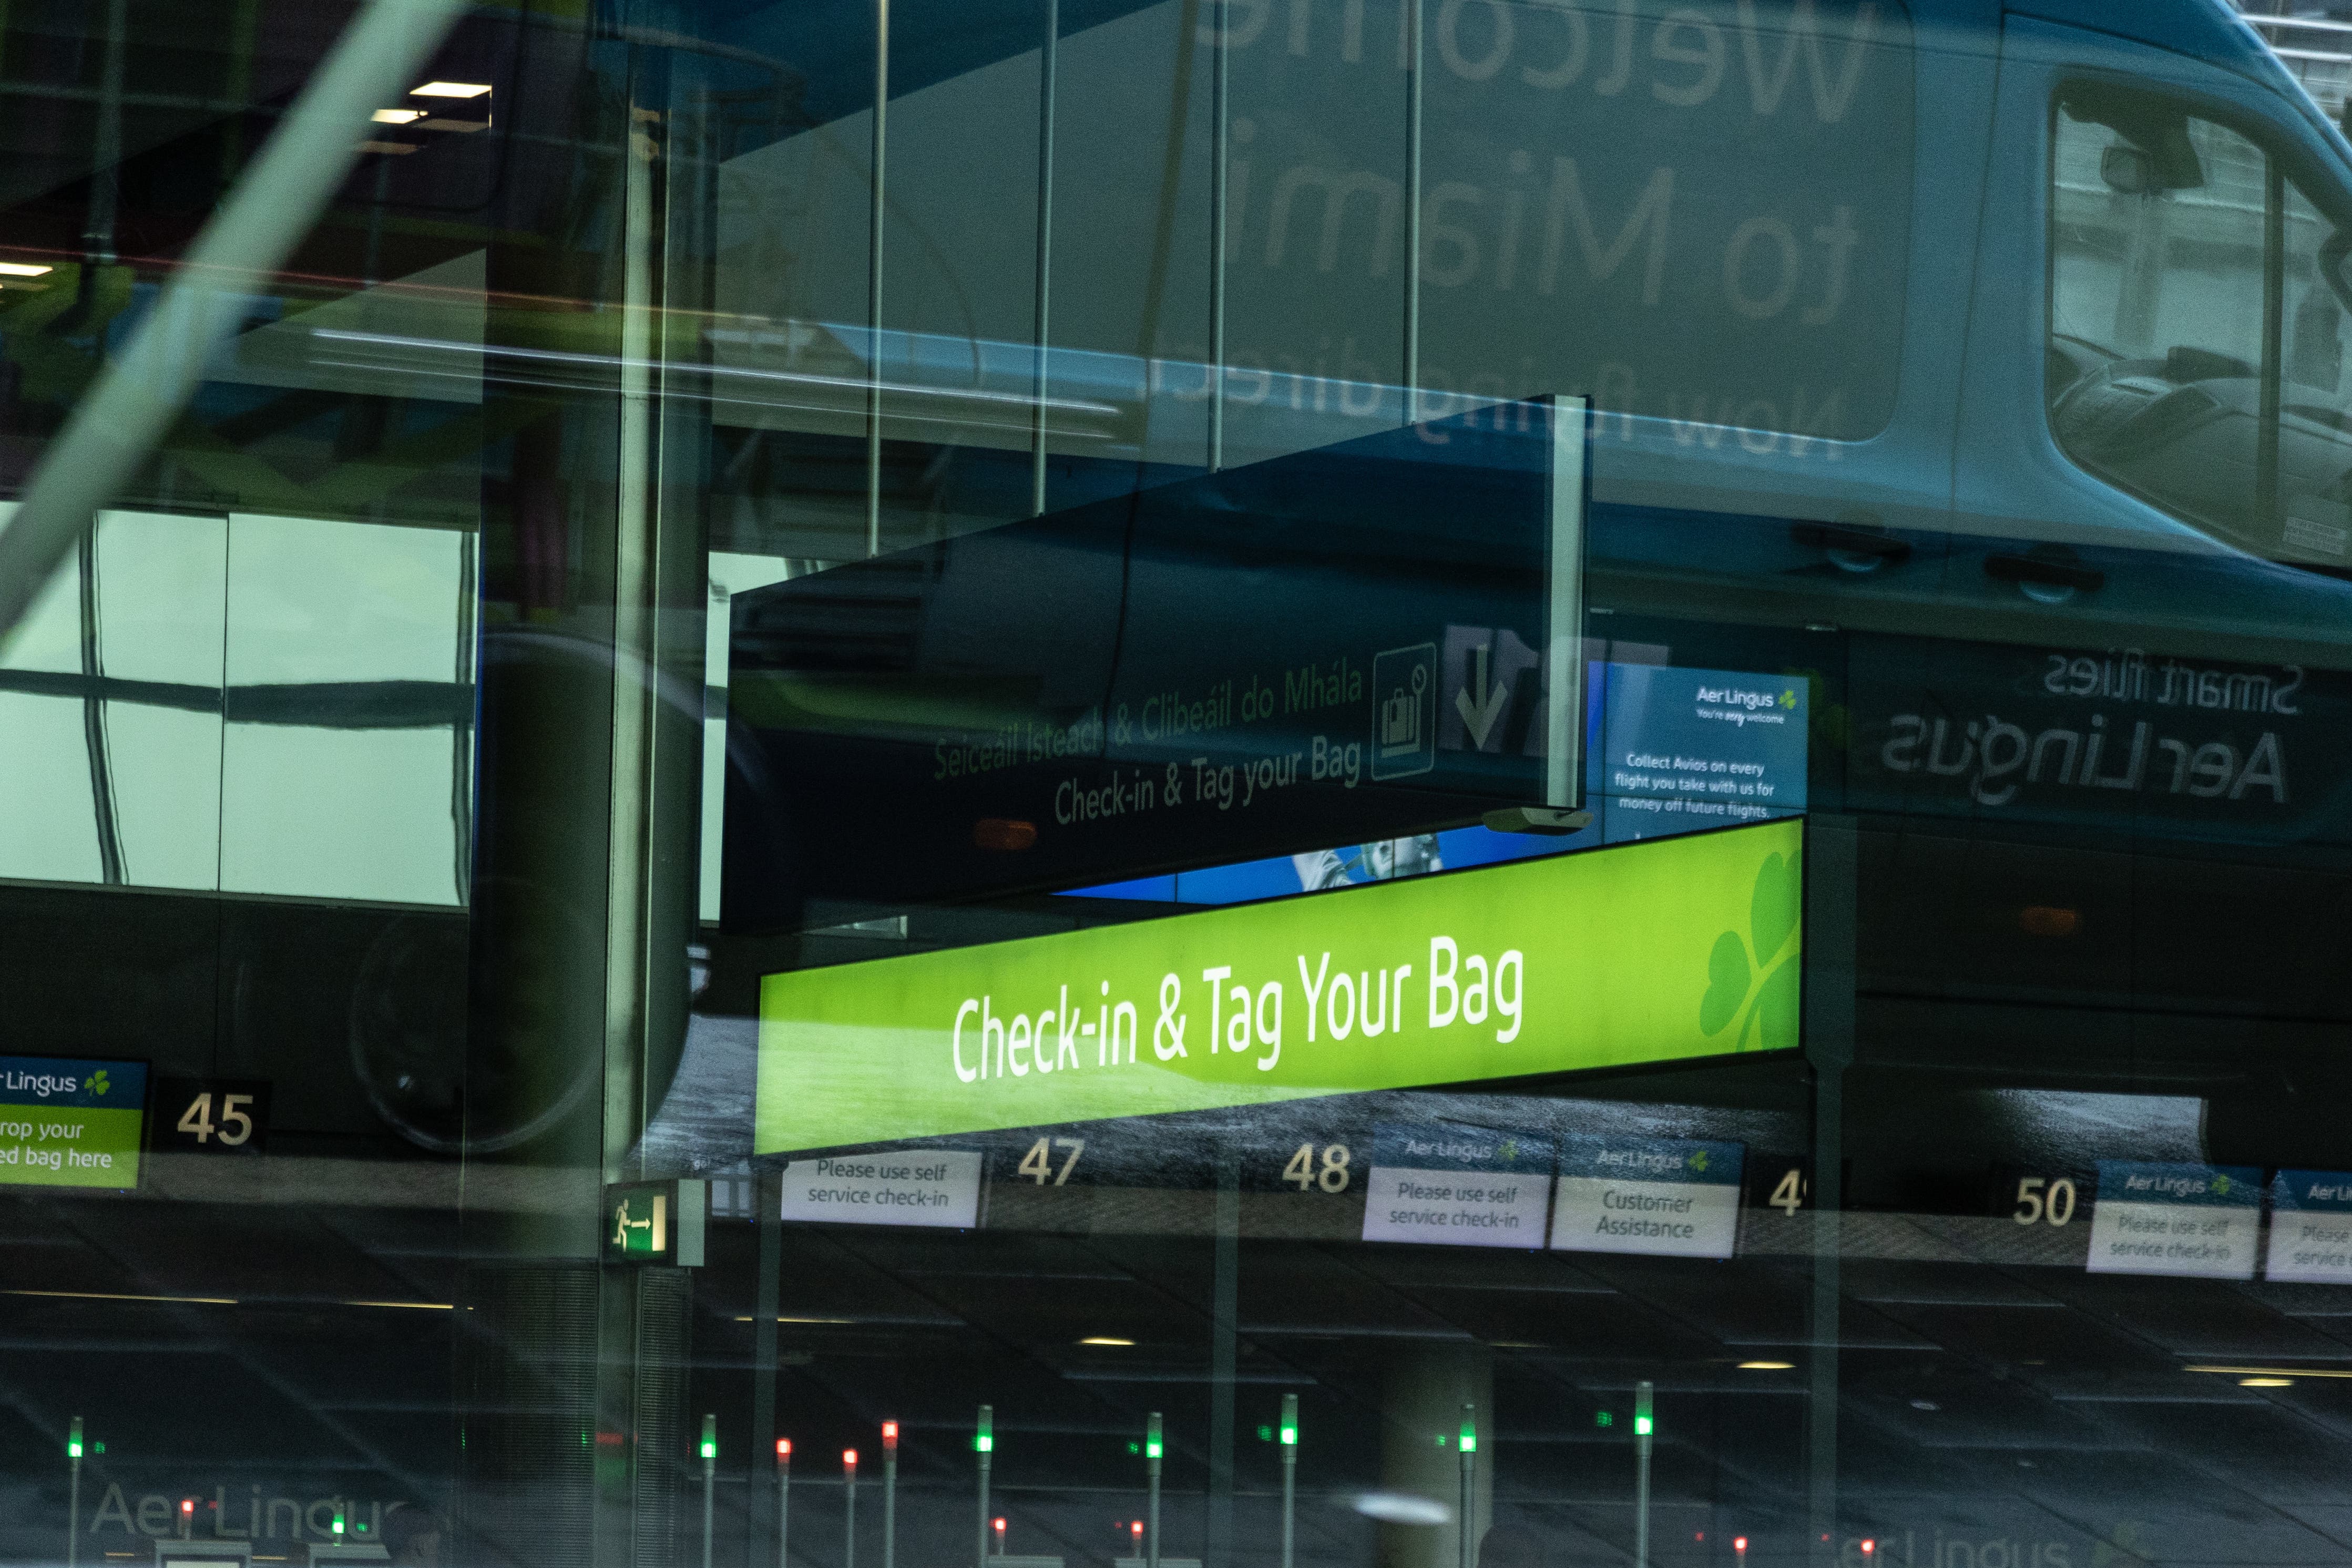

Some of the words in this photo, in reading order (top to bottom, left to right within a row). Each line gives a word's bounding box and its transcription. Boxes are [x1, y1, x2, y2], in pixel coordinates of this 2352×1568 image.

[1117, 702, 1133, 747] &
[1141, 680, 1232, 737] Clibeáil
[1242, 674, 1273, 722] do
[1284, 655, 1362, 714] Mhála
[1696, 686, 1724, 703] Aer
[1724, 689, 1774, 710] Lingus
[1746, 713, 1784, 724] welcome
[1627, 754, 1671, 769] Collect
[1673, 757, 1708, 772] Avios
[1710, 762, 1727, 772] on
[1729, 764, 1765, 778] every
[1055, 768, 1154, 826] Check-in
[1164, 761, 1183, 807] &
[1190, 756, 1234, 812] Tag
[1243, 750, 1303, 806] your
[1311, 734, 1362, 790] Bag
[1615, 773, 1649, 790] flight
[1652, 778, 1676, 791] you
[1678, 778, 1706, 792] take
[1709, 781, 1737, 793] with
[1739, 785, 1754, 795] us
[1757, 783, 1774, 796] for
[1619, 798, 1662, 813] money
[1664, 797, 1683, 811] off
[1685, 798, 1725, 815] future
[1727, 801, 1770, 819] flights.
[953, 980, 1138, 1083] Check-in
[1153, 972, 1188, 1062] &
[1203, 965, 1283, 1072] Tag
[1297, 952, 1412, 1042] Your
[1428, 936, 1523, 1043] Bag
[6, 1070, 77, 1098] Lingus
[177, 1092, 254, 1146] 45
[0, 1121, 33, 1141] rop
[38, 1122, 84, 1142] your
[26, 1145, 62, 1171] bag
[68, 1147, 112, 1169] here
[1018, 1137, 1086, 1186] 47
[1405, 1139, 1436, 1155] Aer
[1438, 1142, 1492, 1163] Lingus
[817, 1159, 875, 1179] Please
[880, 1165, 911, 1180] use
[914, 1163, 947, 1182] self
[1282, 1143, 1351, 1193] 48
[808, 1186, 871, 1204] service
[874, 1187, 949, 1207] check-in
[1397, 1182, 1452, 1202] Please
[1456, 1187, 1484, 1203] use
[1487, 1186, 1517, 1204] self
[1768, 1168, 1807, 1217] 4
[2125, 1174, 2155, 1192] Aer
[2155, 1176, 2206, 1197] Lingus
[2307, 1182, 2336, 1201] Aer
[1602, 1188, 1693, 1213] Customer
[2013, 1177, 2077, 1227] 50
[1389, 1208, 1447, 1226] service
[1451, 1209, 1519, 1228] check-in
[1595, 1215, 1694, 1238] Assistance
[2119, 1214, 2167, 1233] Please
[2171, 1220, 2197, 1235] use
[2302, 1226, 2349, 1243] Please
[2110, 1241, 2163, 1257] service
[2167, 1242, 2231, 1260] check-in
[2294, 1251, 2346, 1266] service
[89, 1481, 203, 1537] Aer
[216, 1483, 409, 1541] Lingu
